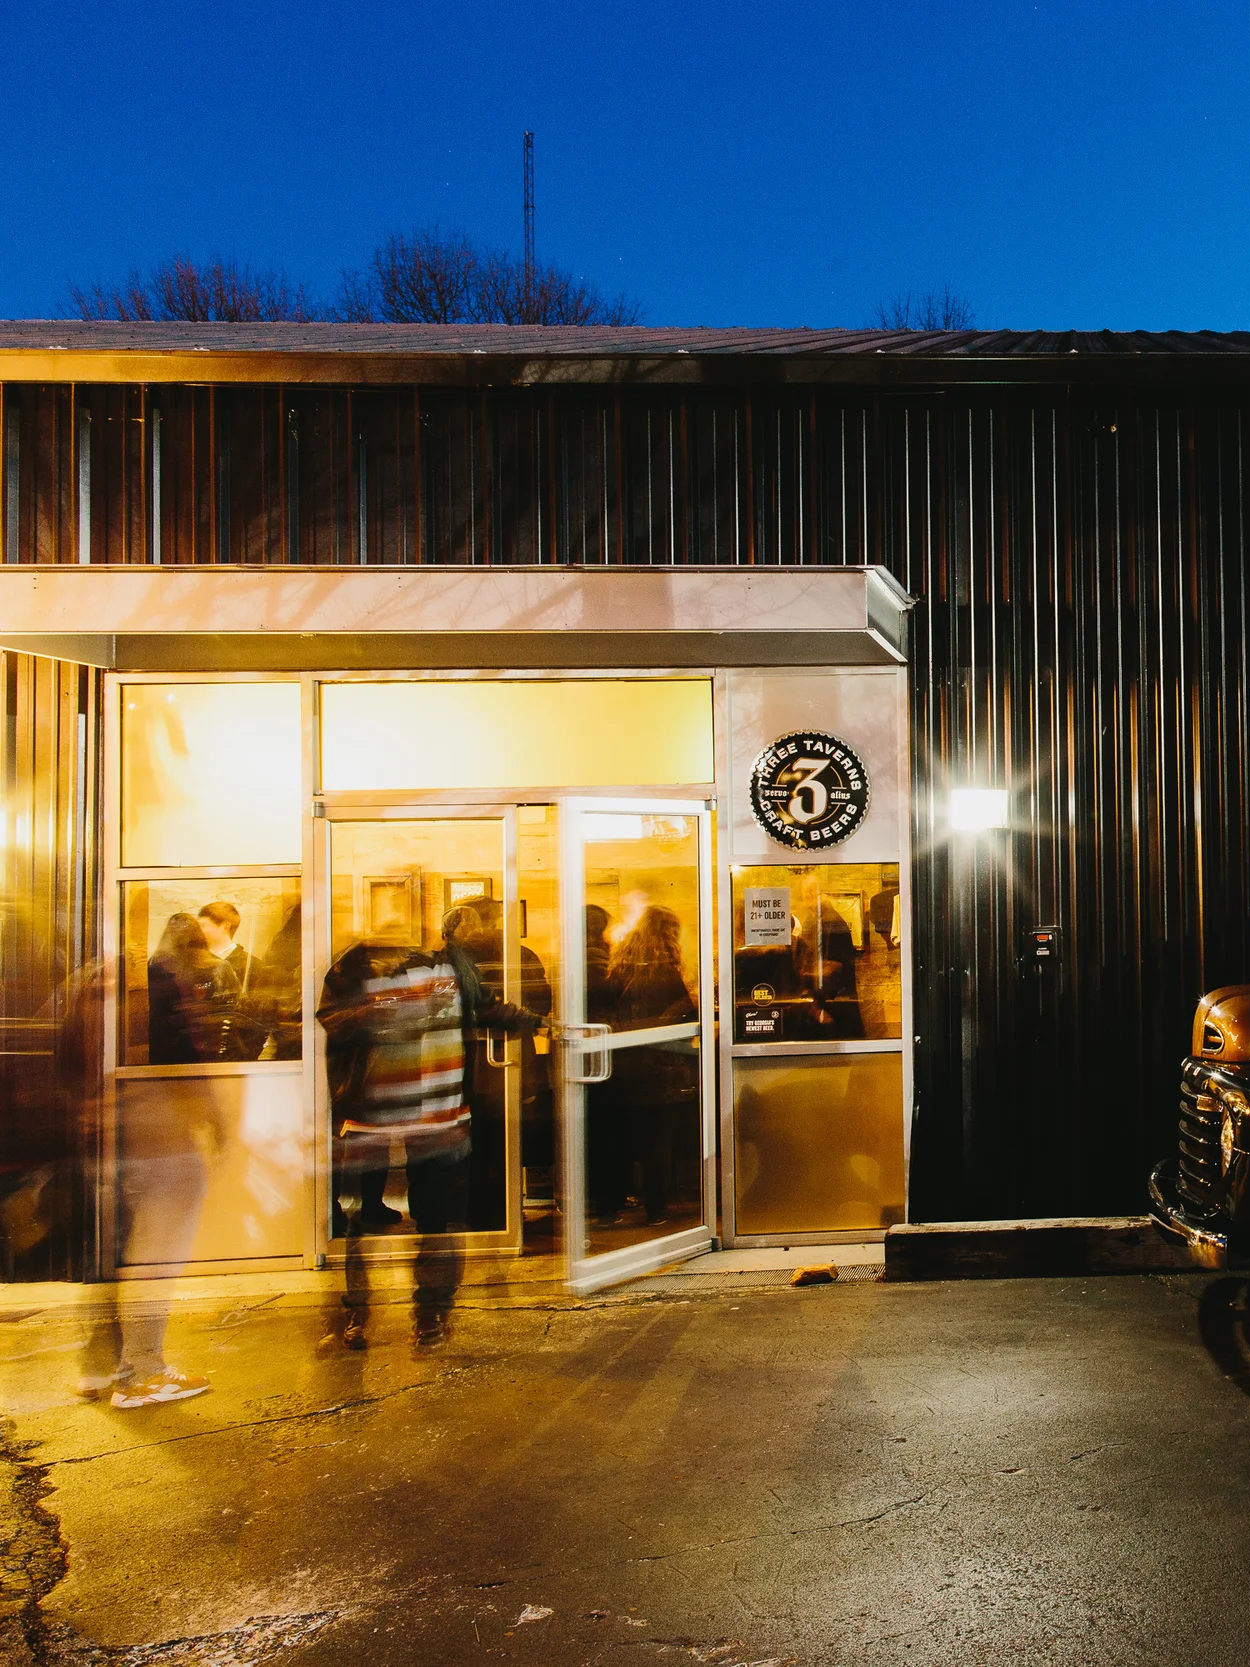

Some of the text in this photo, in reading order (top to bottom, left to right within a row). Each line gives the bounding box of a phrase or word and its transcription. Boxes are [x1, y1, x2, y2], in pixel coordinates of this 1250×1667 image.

[757, 740, 862, 791] THREE TAVERNS
[764, 789, 851, 799] servo alius
[788, 757, 831, 824] 3
[759, 799, 858, 841] CRAFT BEERS
[750, 911, 786, 920] 21+ OLDER
[752, 899, 781, 908] MUST BE
